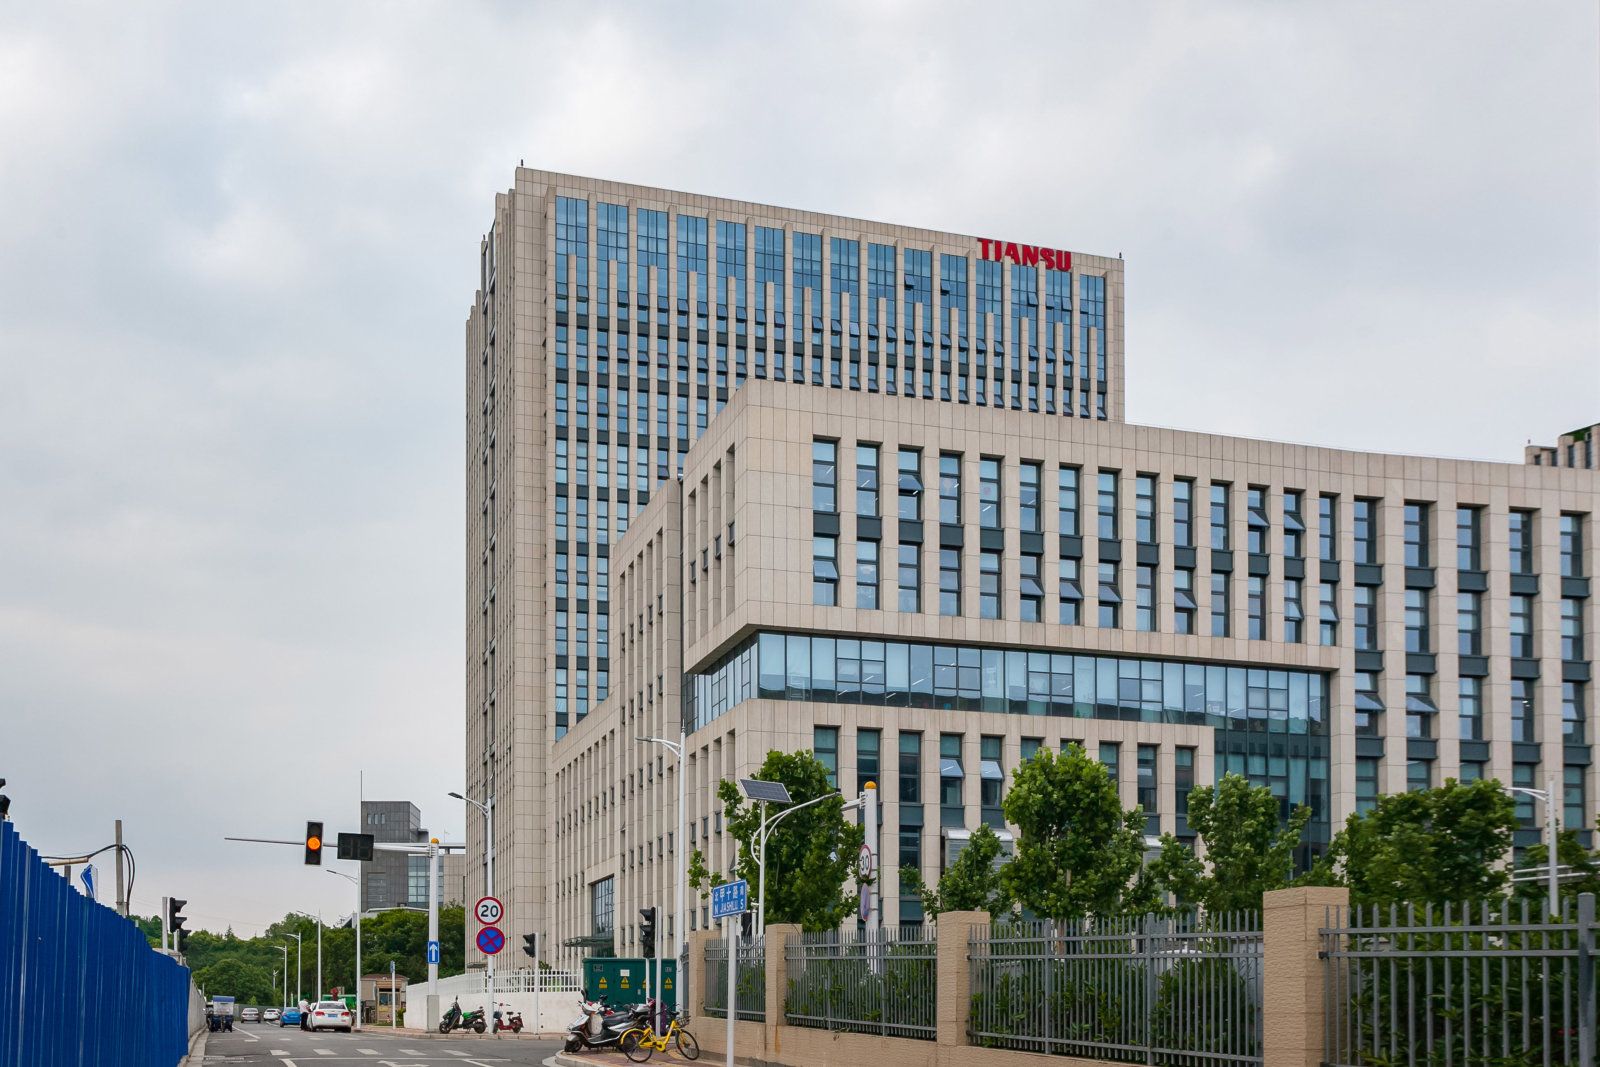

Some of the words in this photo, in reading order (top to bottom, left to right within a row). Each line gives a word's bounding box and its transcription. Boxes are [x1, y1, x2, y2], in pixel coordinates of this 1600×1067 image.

[977, 238, 1071, 272] TIANSU
[860, 854, 870, 871] 30
[480, 904, 499, 918] 20
[714, 904, 719, 915] N
[740, 898, 744, 910] S
